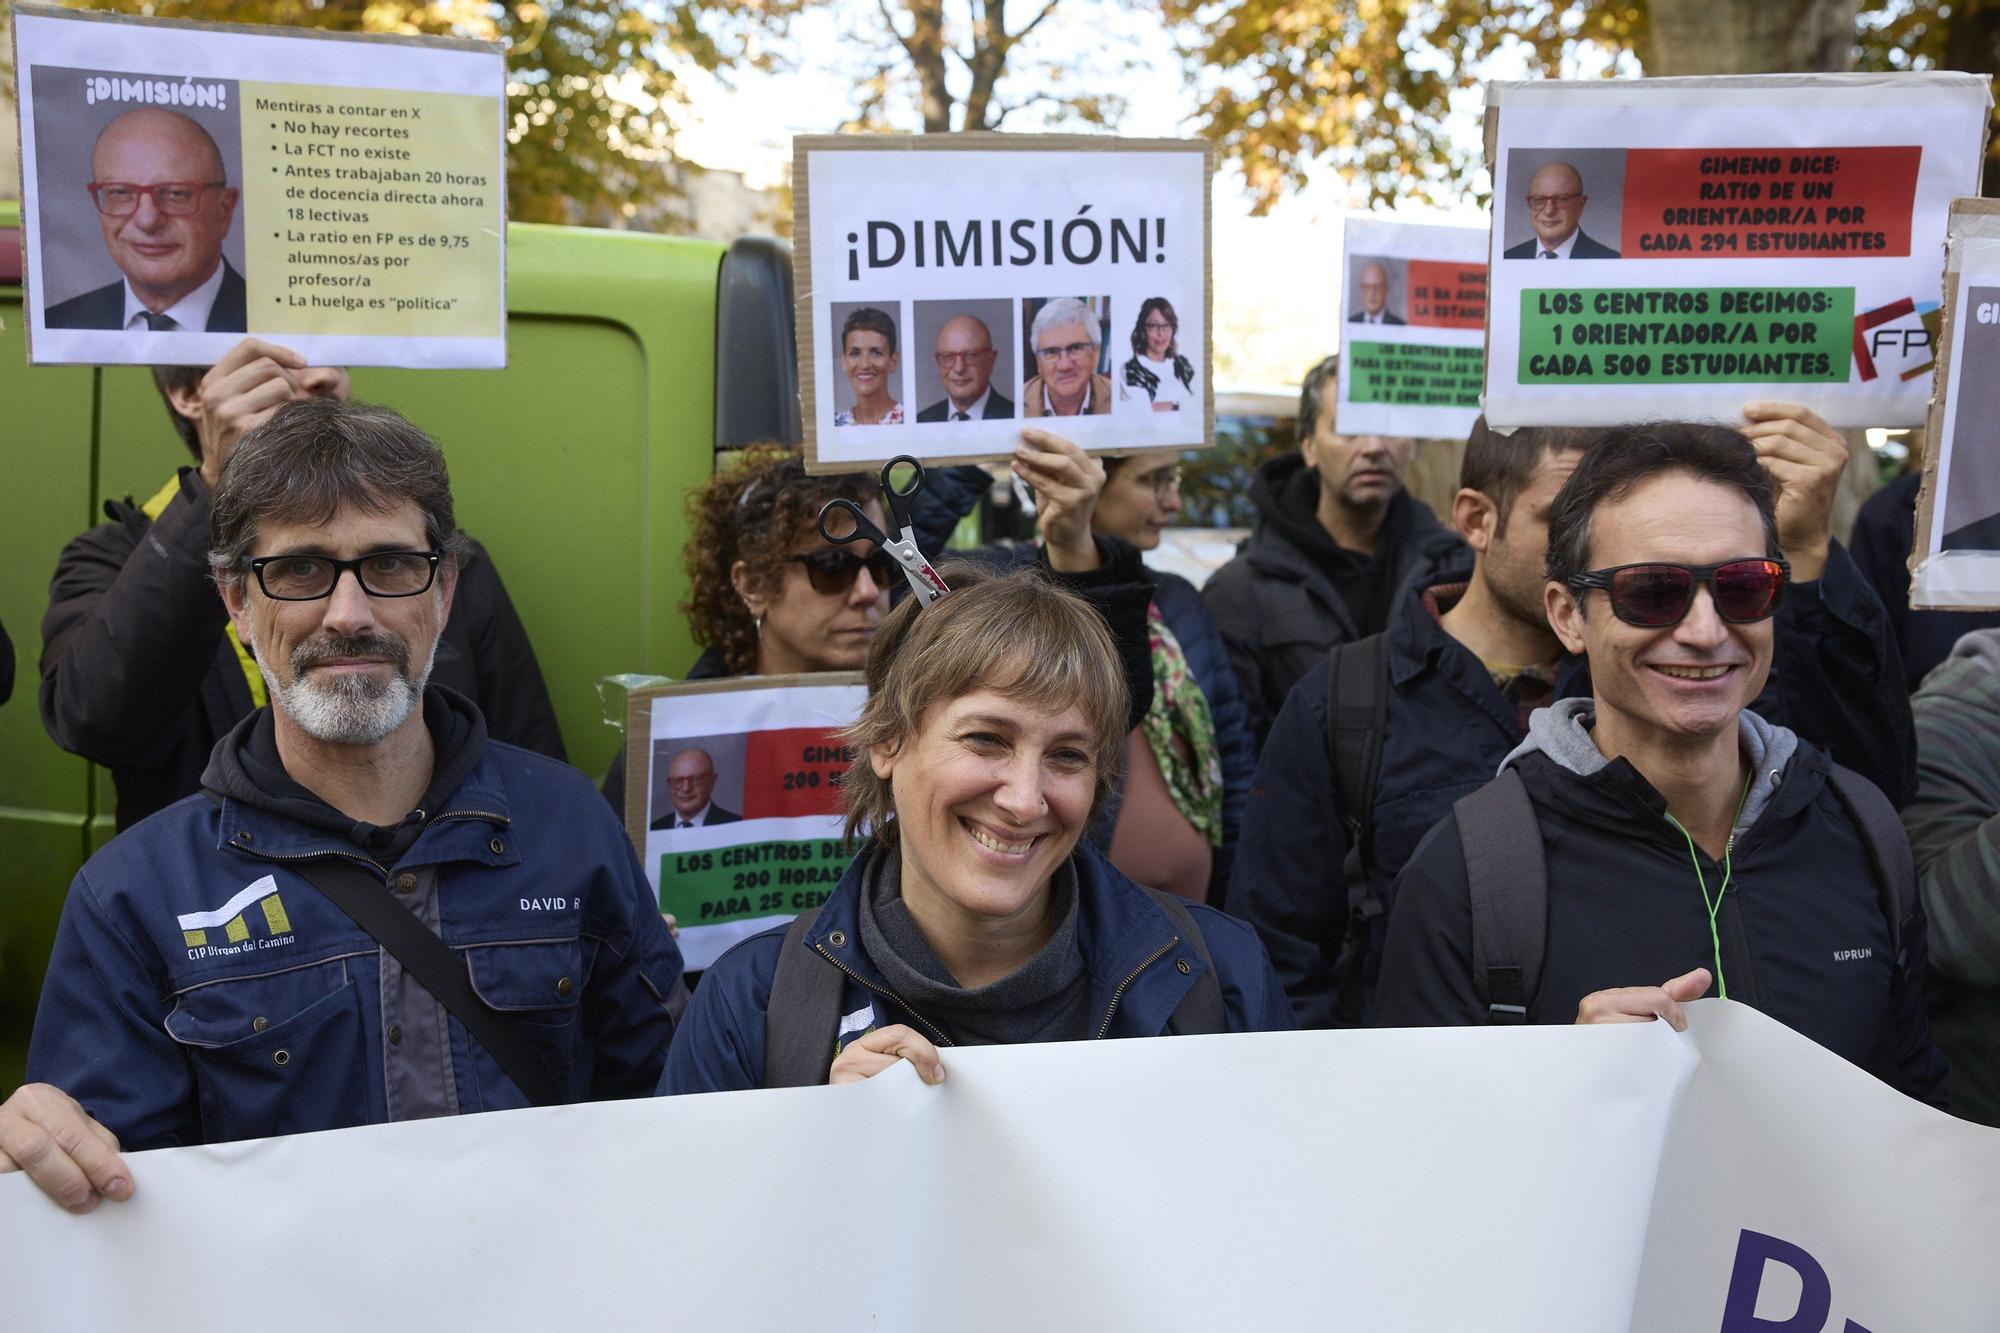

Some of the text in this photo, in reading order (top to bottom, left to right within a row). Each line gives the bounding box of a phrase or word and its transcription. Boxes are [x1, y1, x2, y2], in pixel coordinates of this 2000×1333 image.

[86, 76, 226, 111] ¡DIMISIÓN!
[255, 98, 421, 120] Mentiras a contar en X
[284, 120, 410, 140] No hay recortes
[284, 142, 411, 161] La FCT no existe
[285, 163, 488, 187] Antes trabajaban 20 horas
[1699, 155, 1841, 176] GIMENO DICE:
[286, 185, 484, 208] de docencia directa ahora
[1699, 181, 1834, 200] RATIO DE UN
[287, 207, 370, 224] 18 lectivas
[1662, 206, 1866, 226] ORIENTADOR/A POR
[287, 229, 470, 250] La ratio en FP es de 9,75
[846, 203, 1167, 281] ¡DIMISIÓN!
[1639, 231, 1887, 252] CADA 294 ESTUDIANTES
[288, 250, 411, 270] alumnos/as por
[288, 272, 372, 288] profesor/a
[289, 294, 308, 307] La
[312, 295, 364, 312] huelga
[368, 298, 386, 309] es
[1538, 291, 1834, 315] LOS CENTROS DECIMOS:
[1976, 302, 2000, 325] GI
[1552, 321, 1818, 346] 1 ORIENTADOR/A POR
[1872, 329, 1932, 358] FP
[1529, 352, 1836, 377] CADA 500 ESTUDIANTES.
[783, 771, 820, 791] 200
[676, 853, 713, 874] LOS
[721, 842, 813, 867] CENTROS
[733, 866, 844, 891] 200 HORAS
[520, 897, 566, 911] DAVID
[701, 897, 752, 919] PARA
[759, 892, 784, 912] 25
[187, 947, 206, 961] CIP
[258, 935, 295, 950] Camino
[1833, 947, 1873, 961] KIPRUN
